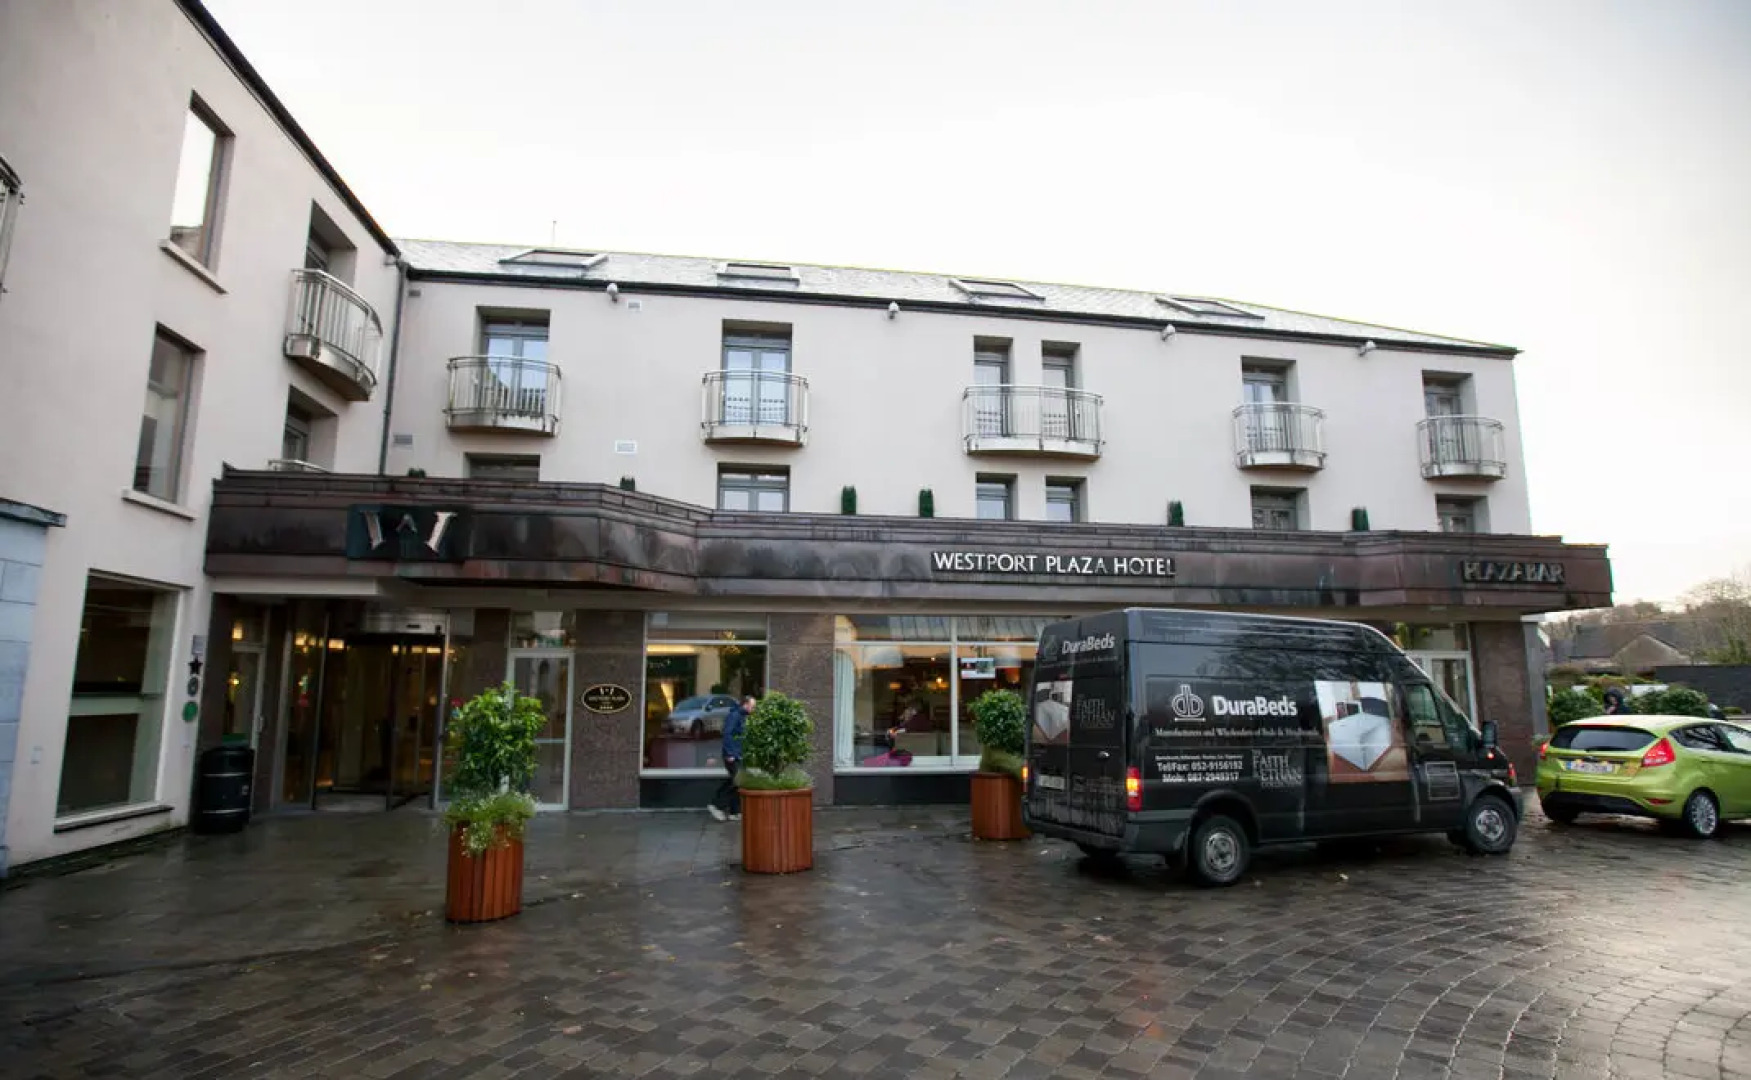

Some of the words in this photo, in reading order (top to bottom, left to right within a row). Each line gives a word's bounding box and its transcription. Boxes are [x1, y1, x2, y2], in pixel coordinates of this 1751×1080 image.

[933, 552, 1038, 572] WESTPORT
[1045, 555, 1108, 574] PLAZA
[1113, 557, 1176, 575] HOTEL
[1061, 633, 1117, 655] DuraBeds
[1212, 695, 1298, 716] DuraBeds
[1253, 755, 1289, 768] FAITH
